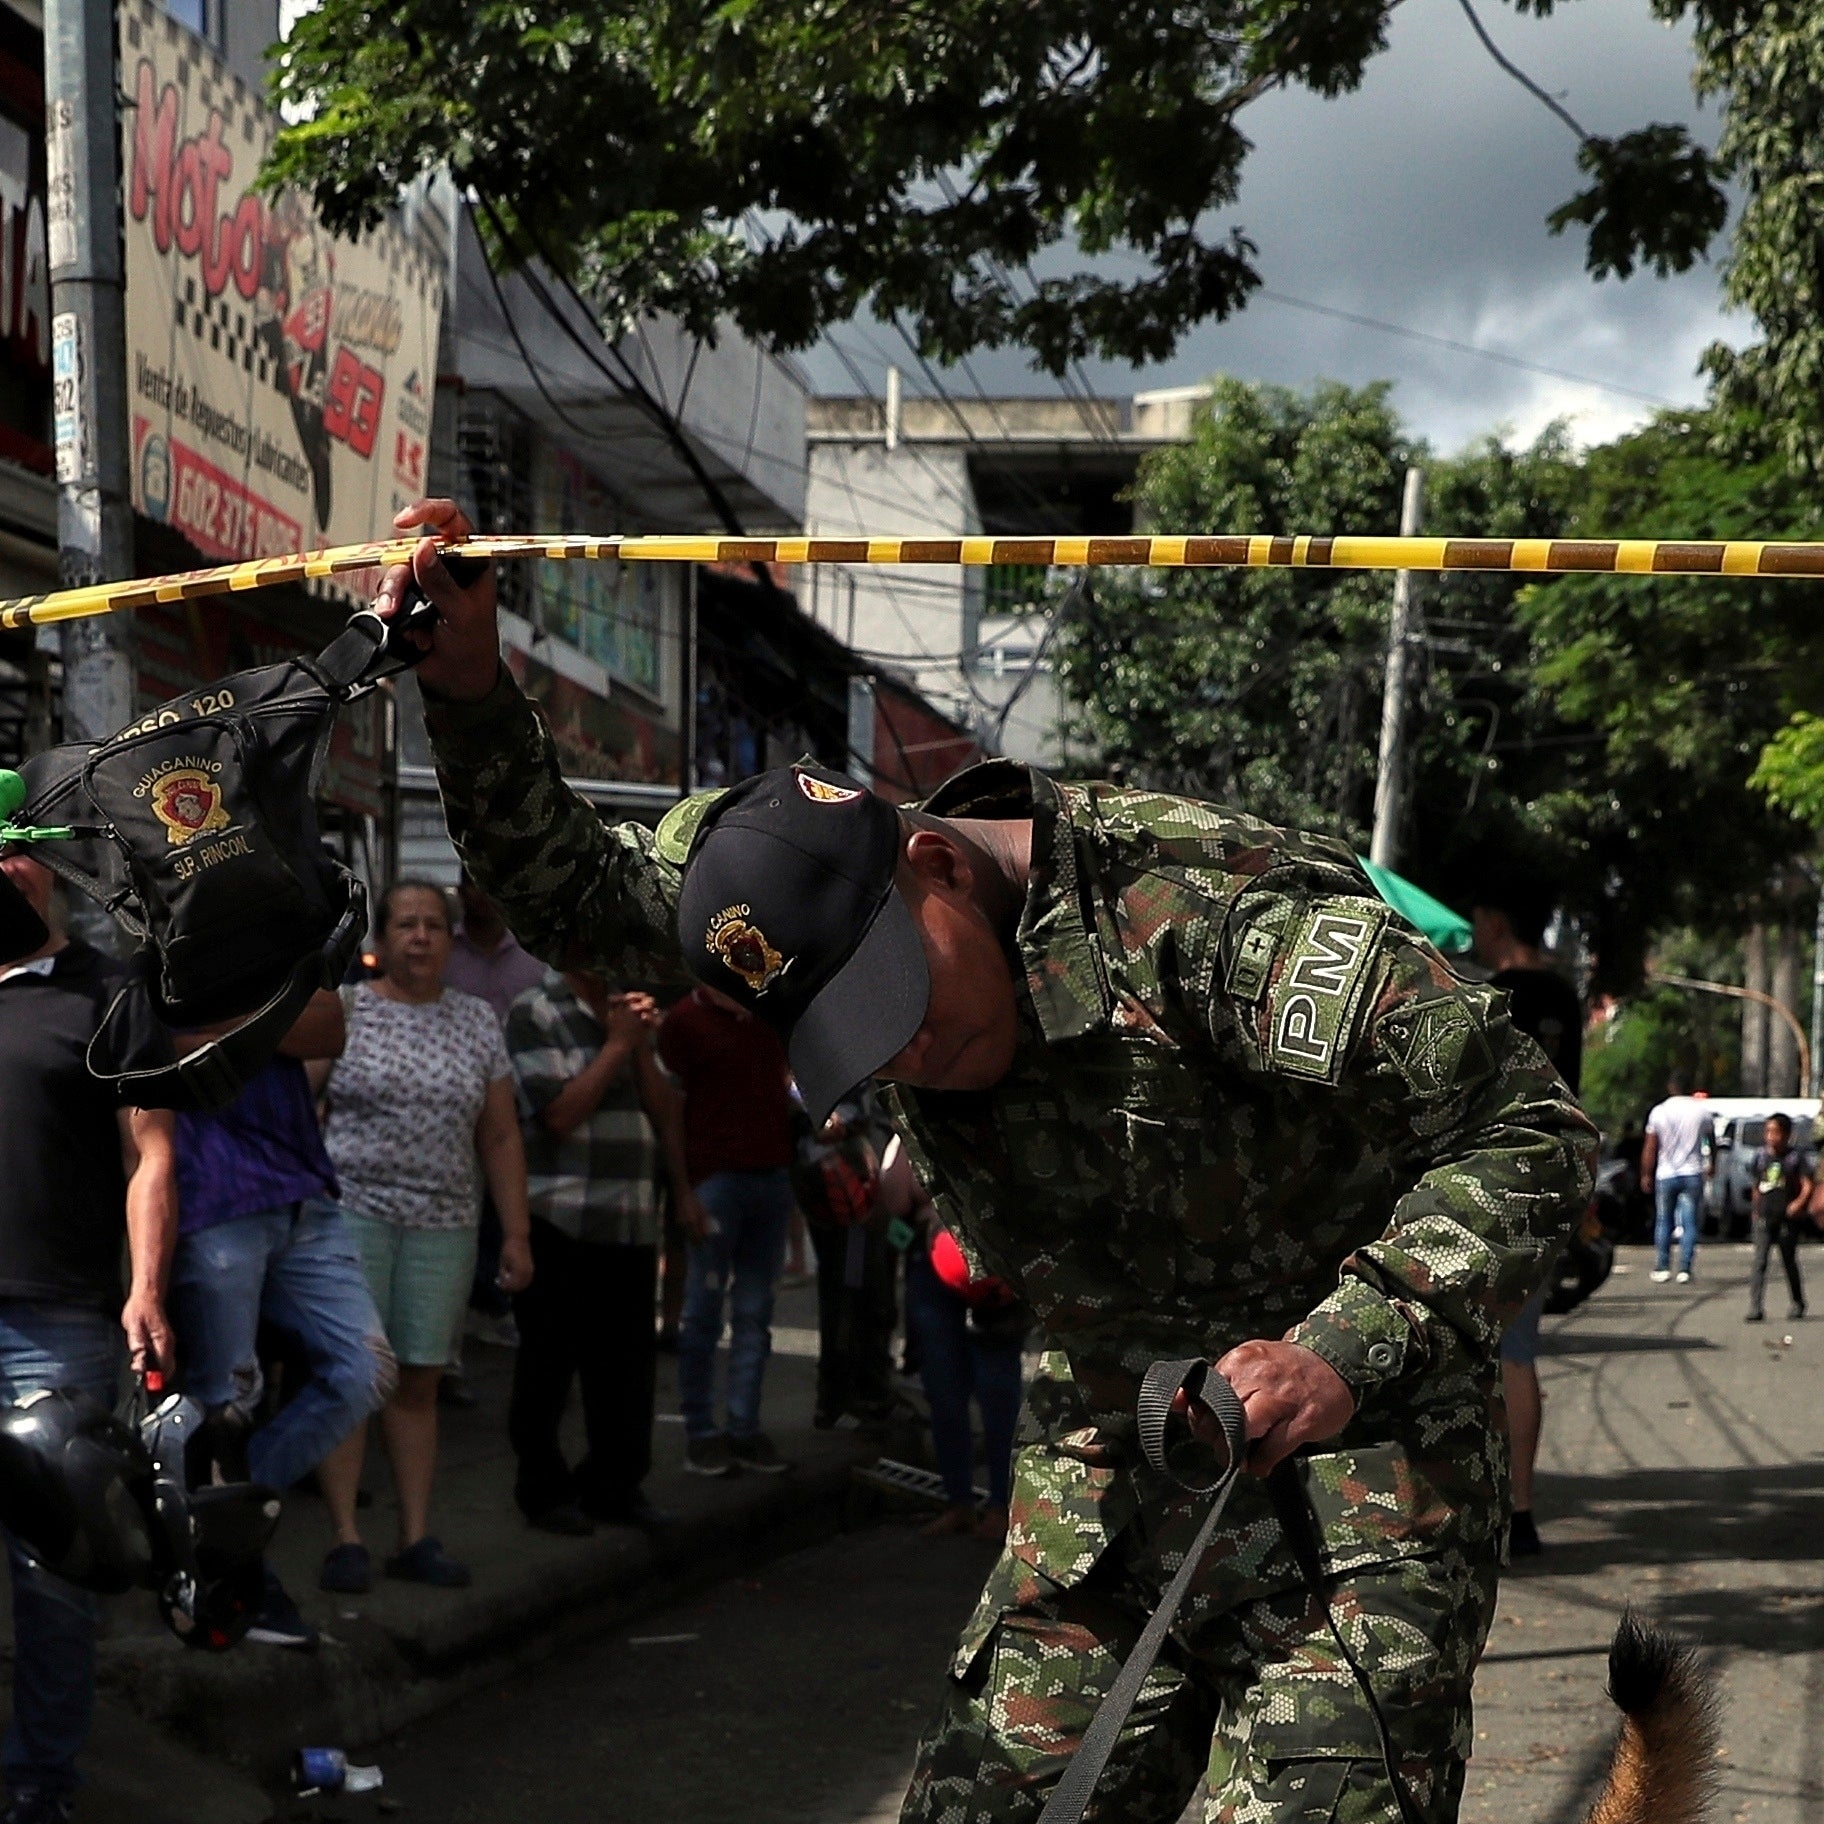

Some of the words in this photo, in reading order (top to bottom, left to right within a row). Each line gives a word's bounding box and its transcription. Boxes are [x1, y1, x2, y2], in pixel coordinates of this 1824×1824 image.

[322, 345, 386, 458] 93
[179, 465, 221, 538] 602
[190, 688, 235, 718] 120
[1277, 912, 1369, 1063] PM
